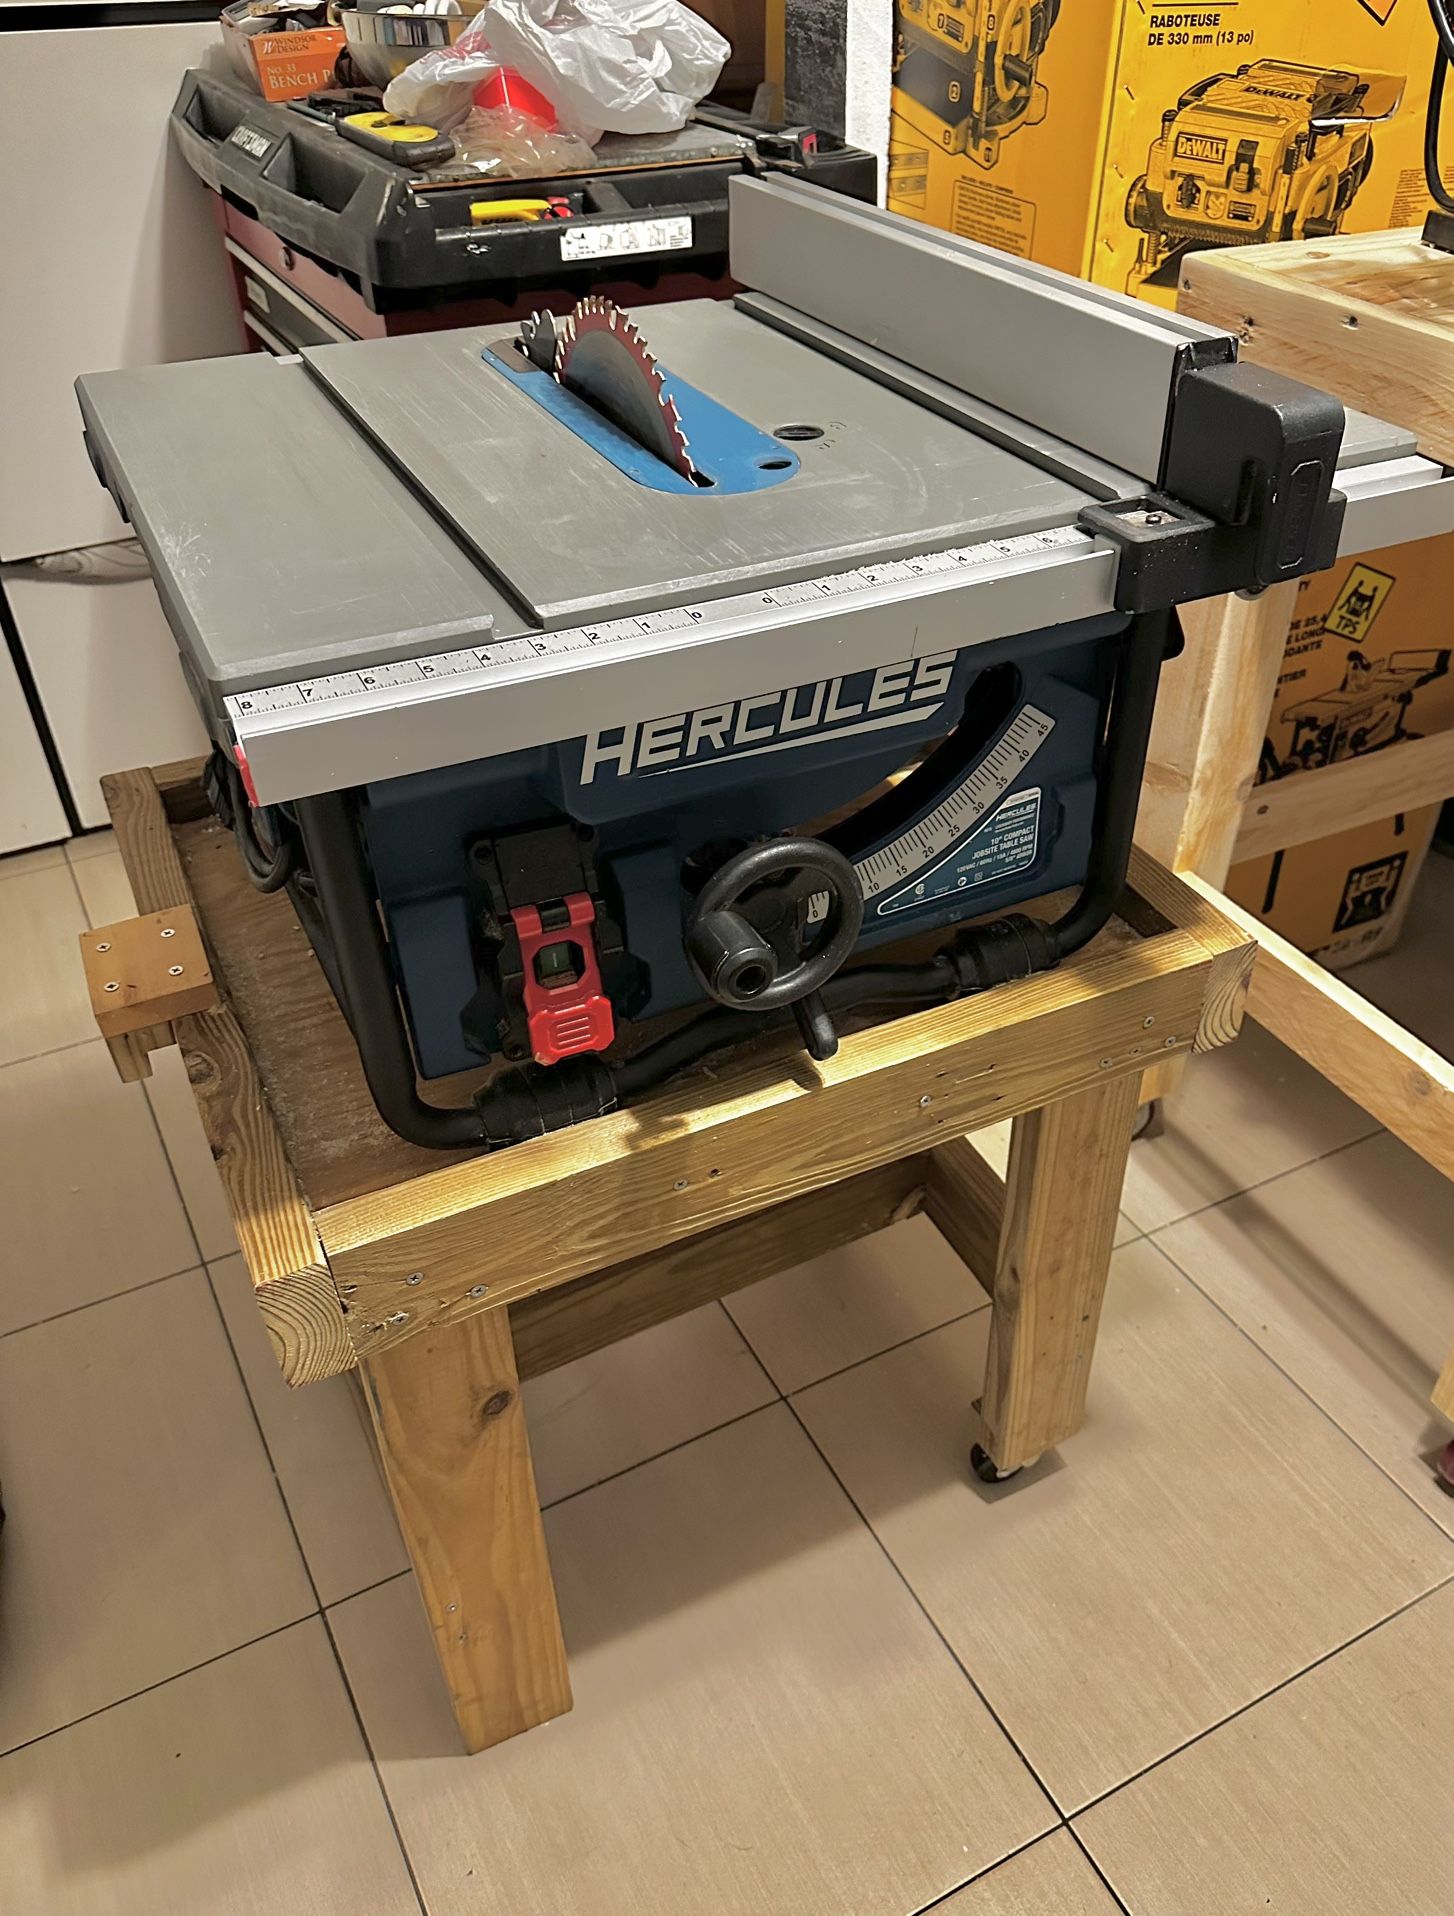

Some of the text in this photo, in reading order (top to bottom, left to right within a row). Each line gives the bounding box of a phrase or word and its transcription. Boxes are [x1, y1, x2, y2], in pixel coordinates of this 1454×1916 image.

[1149, 13, 1221, 28] RABOTEUSE
[273, 34, 317, 45] WINDSOR
[1147, 30, 1254, 46] DE 330 mm (13 po)
[277, 43, 310, 54] DESIGN
[287, 63, 297, 72] 33
[268, 71, 318, 89] BENCH
[1177, 136, 1225, 161] DEWALT
[821, 584, 831, 592] 1
[867, 574, 878, 582] 2
[957, 555, 968, 563] 4
[1000, 545, 1011, 553] 5
[1041, 536, 1053, 544] 6
[1335, 614, 1361, 635] TPS
[241, 610, 703, 709] 8 7 6 5 4 3 2 1 0
[579, 649, 958, 786] HERCULES
[1036, 722, 1049, 738] 45
[1018, 750, 1030, 763] 40
[995, 777, 1008, 790] 35
[972, 802, 985, 814] 30
[995, 802, 1037, 822] HERCULES
[949, 825, 961, 837] 25
[1003, 825, 1035, 842] COMPACT
[923, 846, 935, 858] 20
[971, 833, 1035, 860] JOBSITE TABLE SAW
[896, 866, 907, 877] 15
[868, 882, 880, 893] 10
[812, 909, 819, 919] 0
